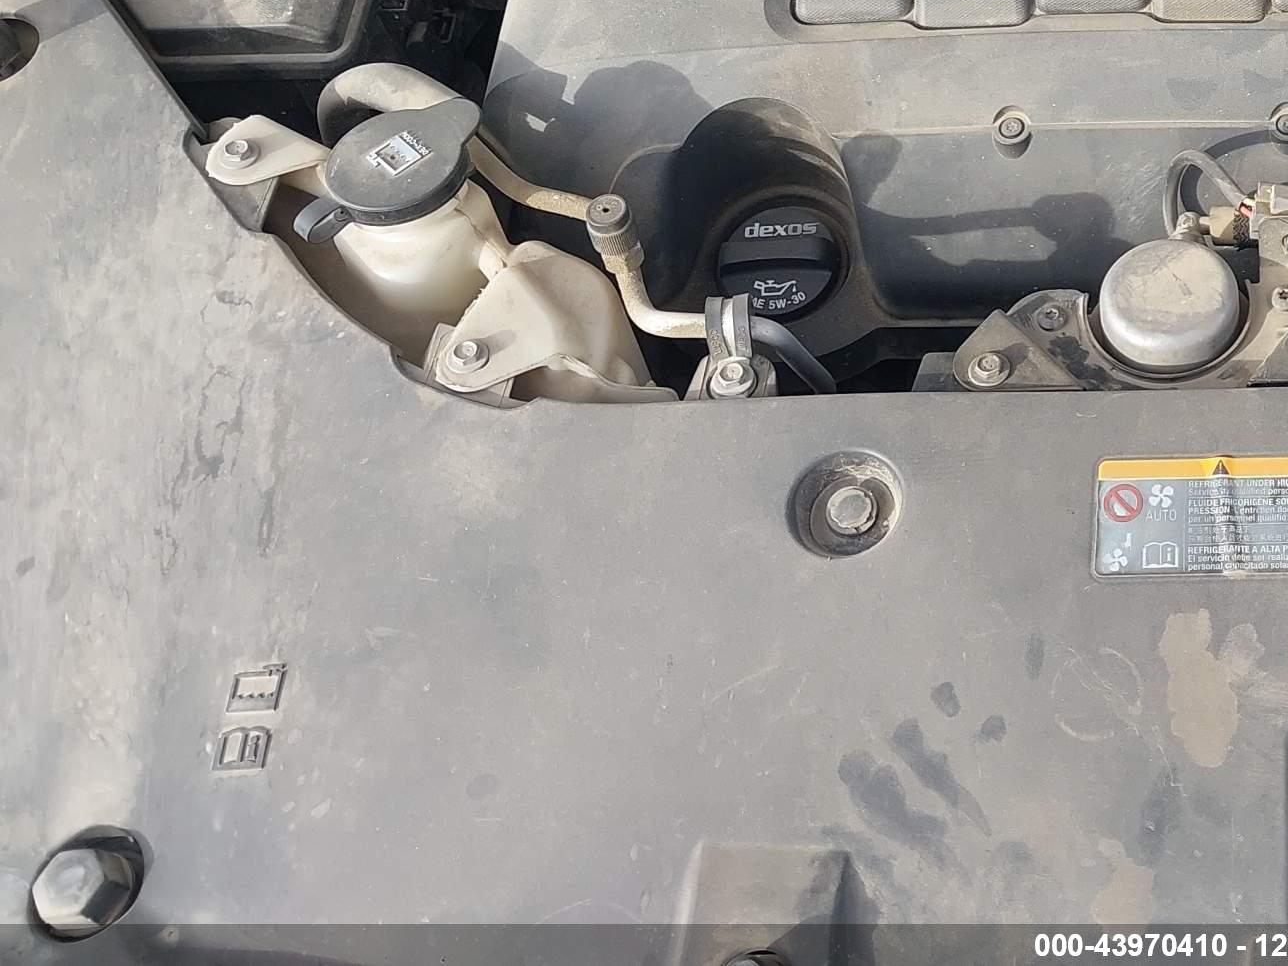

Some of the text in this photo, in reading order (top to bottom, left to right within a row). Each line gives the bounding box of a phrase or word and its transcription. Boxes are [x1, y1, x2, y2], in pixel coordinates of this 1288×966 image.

[744, 222, 820, 239] dexos
[751, 291, 806, 310] AE 5W-30
[1188, 479, 1244, 489] REFRIGERANT
[1246, 478, 1275, 487] UNDER
[1188, 498, 1219, 507] FLUIDE
[1145, 509, 1178, 522] AUTO
[1188, 544, 1250, 554] REFRIGERANTE
[1260, 544, 1281, 553] ALTA
[1198, 554, 1230, 563] servicio
[1188, 562, 1224, 572] personal
